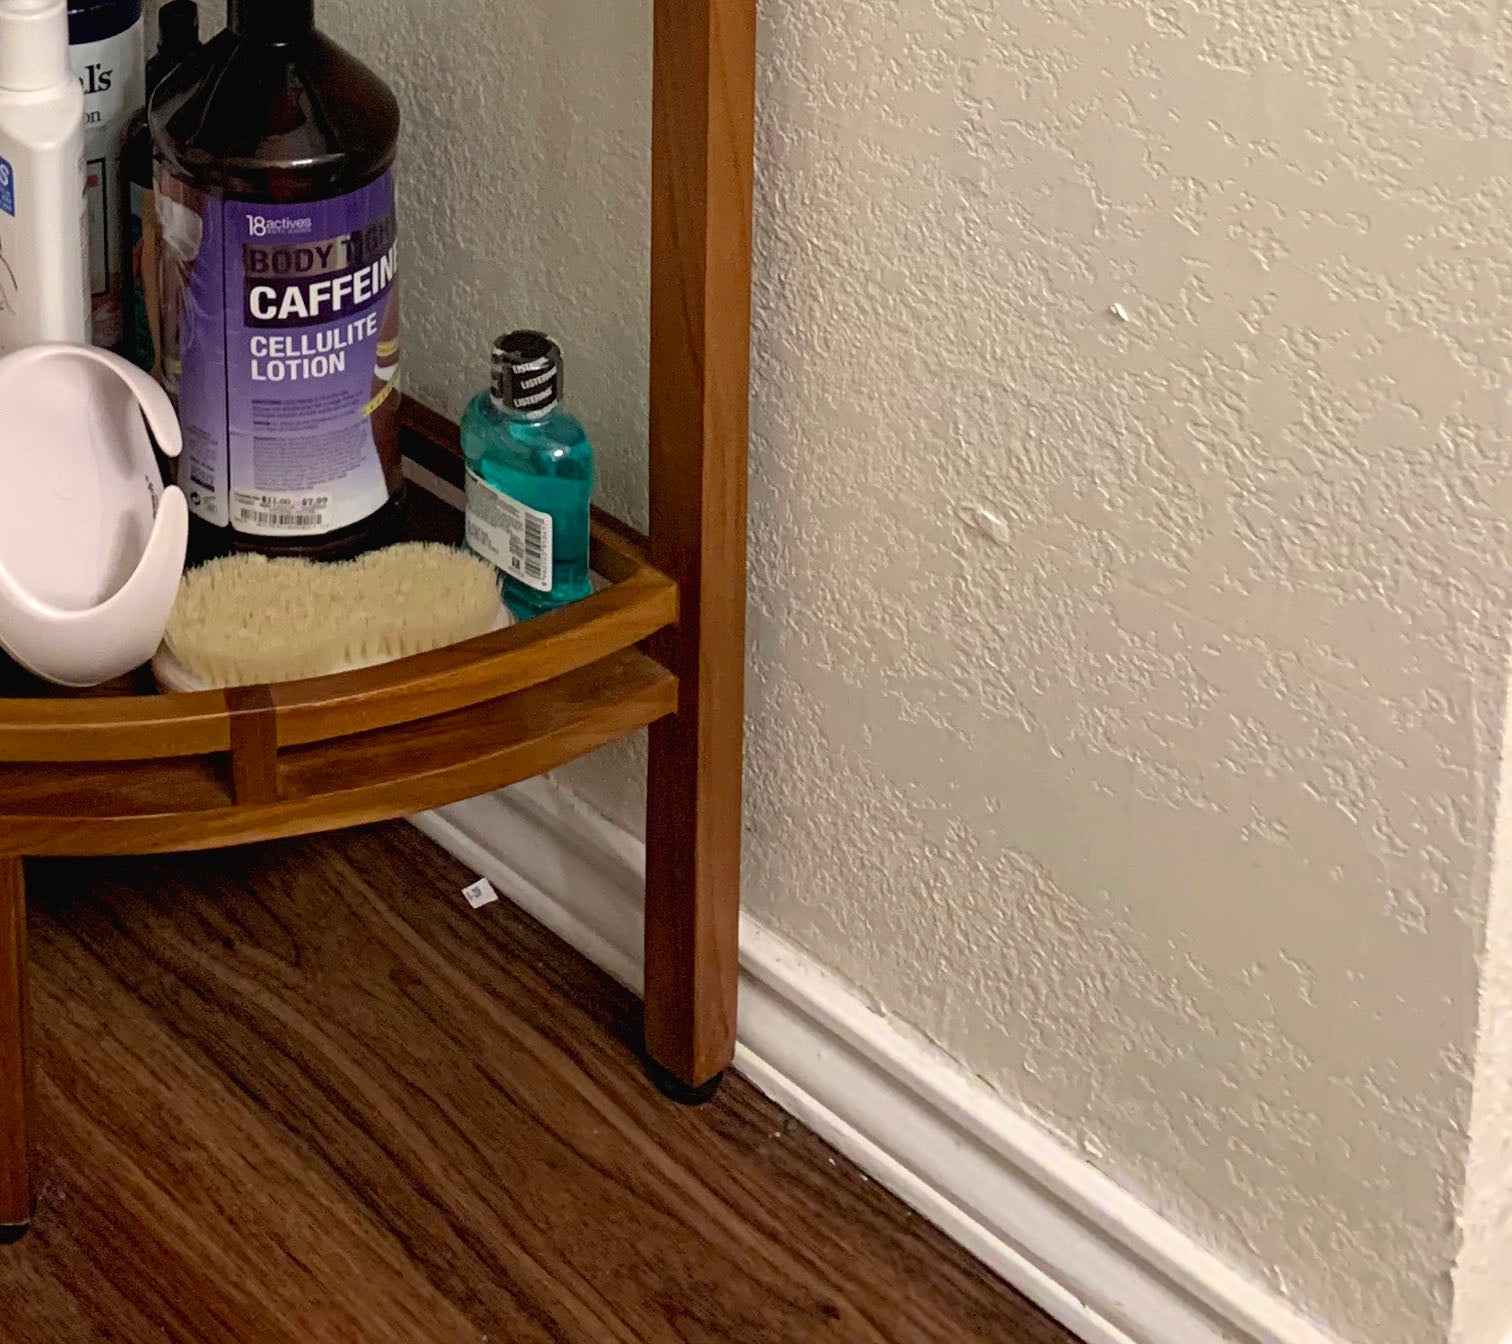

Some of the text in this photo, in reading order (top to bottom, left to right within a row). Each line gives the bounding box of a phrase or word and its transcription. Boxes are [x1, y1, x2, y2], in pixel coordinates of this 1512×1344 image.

[250, 245, 333, 274] BODY
[250, 311, 378, 358] CELLULITE
[251, 350, 346, 382] LOTION
